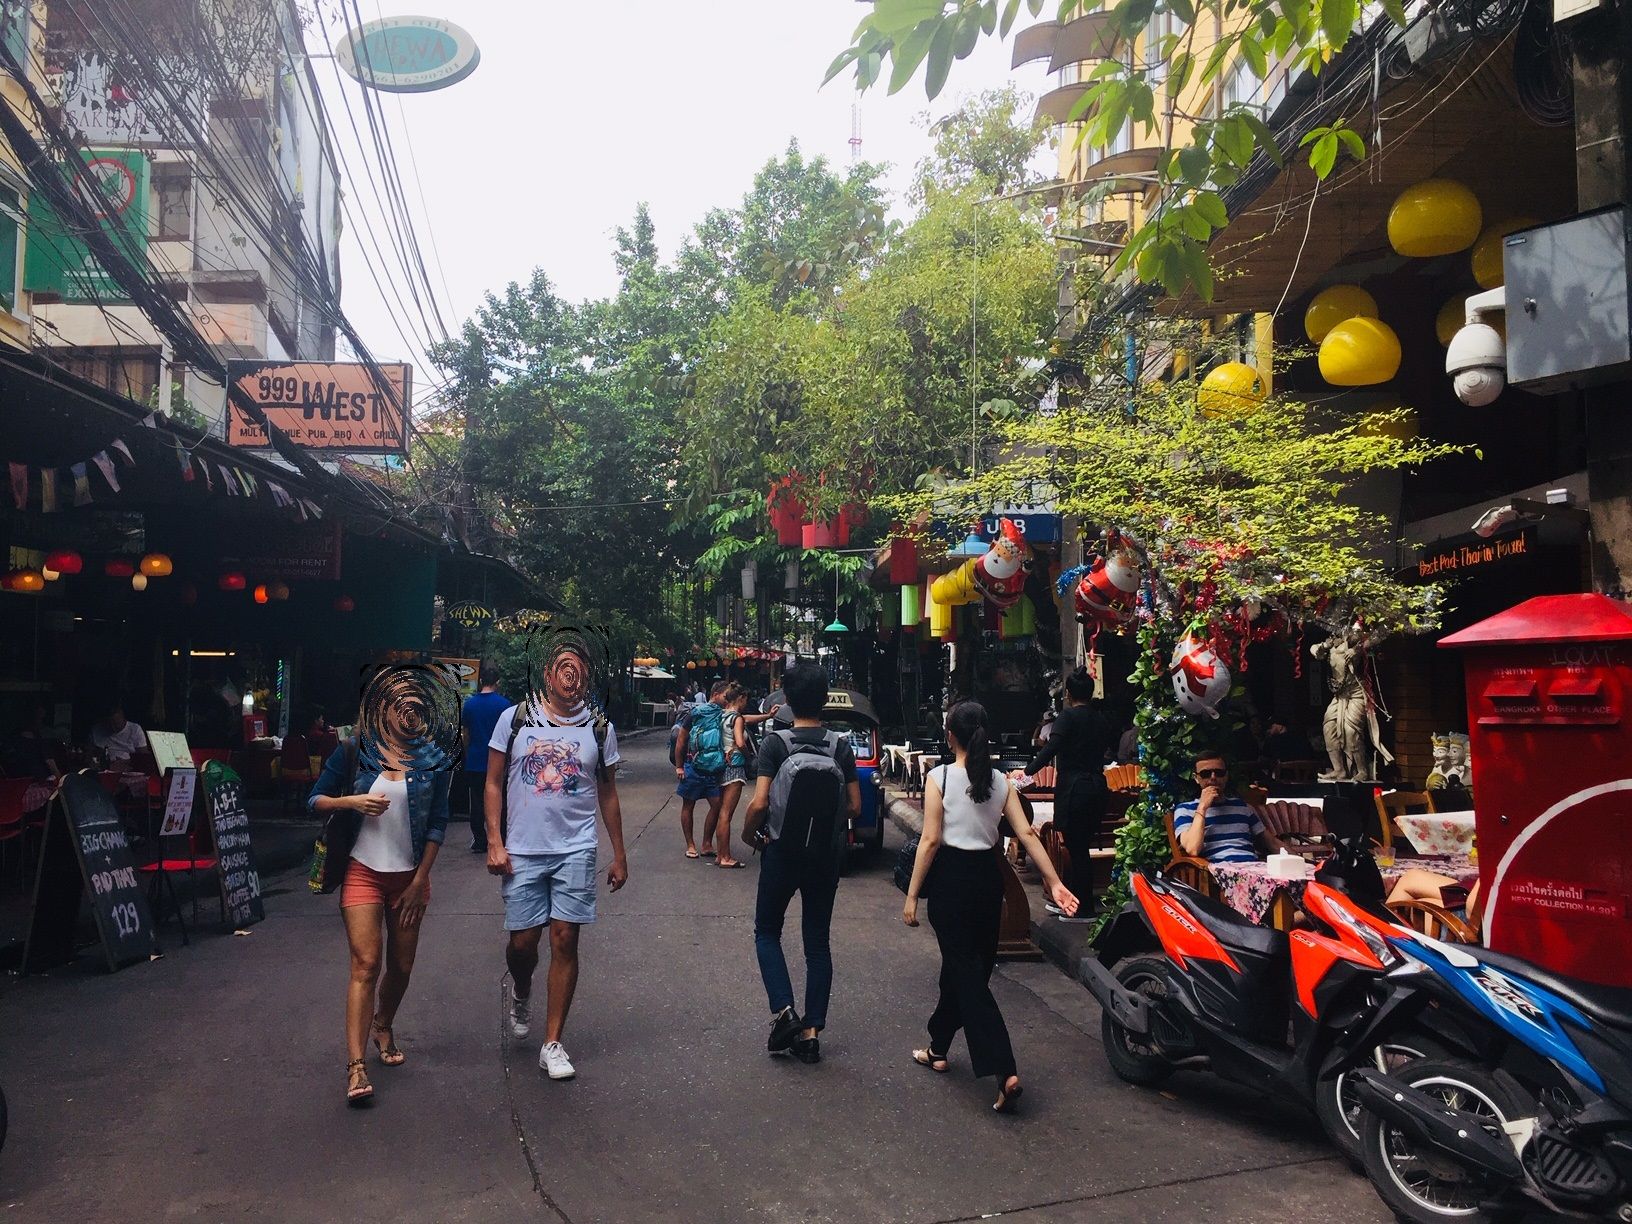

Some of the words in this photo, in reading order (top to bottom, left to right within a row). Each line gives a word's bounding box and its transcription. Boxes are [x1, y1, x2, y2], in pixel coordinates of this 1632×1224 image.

[258, 375, 298, 402] 999
[302, 381, 380, 423] WEST
[334, 430, 353, 441] BBQ
[448, 604, 492, 620] SHEWA
[1533, 898, 1584, 912] COLLECTION
[111, 901, 140, 938] 129
